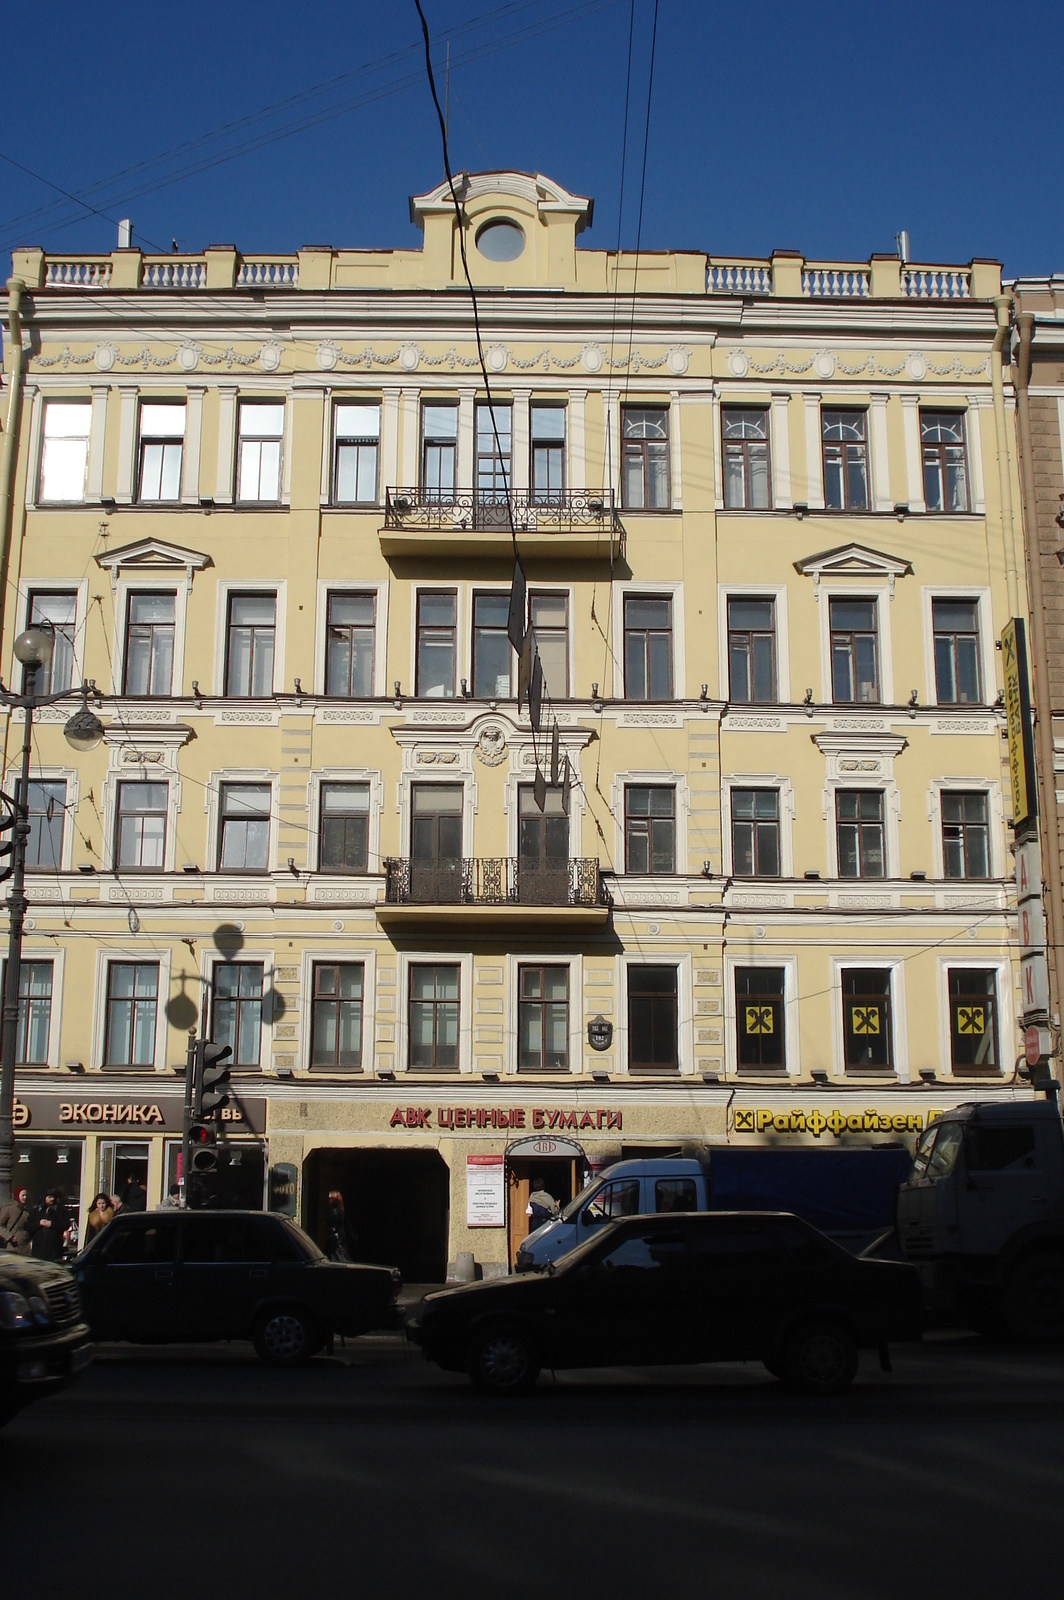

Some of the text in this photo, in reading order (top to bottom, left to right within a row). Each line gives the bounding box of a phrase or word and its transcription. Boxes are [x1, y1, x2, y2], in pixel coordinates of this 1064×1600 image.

[1012, 672, 1021, 735] БАНК
[1008, 674, 1020, 817] Райффайзен
[1020, 853, 1034, 1005] АВК
[59, 1103, 163, 1122] ЭКОНИКА
[390, 1107, 622, 1129] АВК ЦЕННЫЕ БУМАГИ
[757, 1109, 923, 1135] Райффайзен
